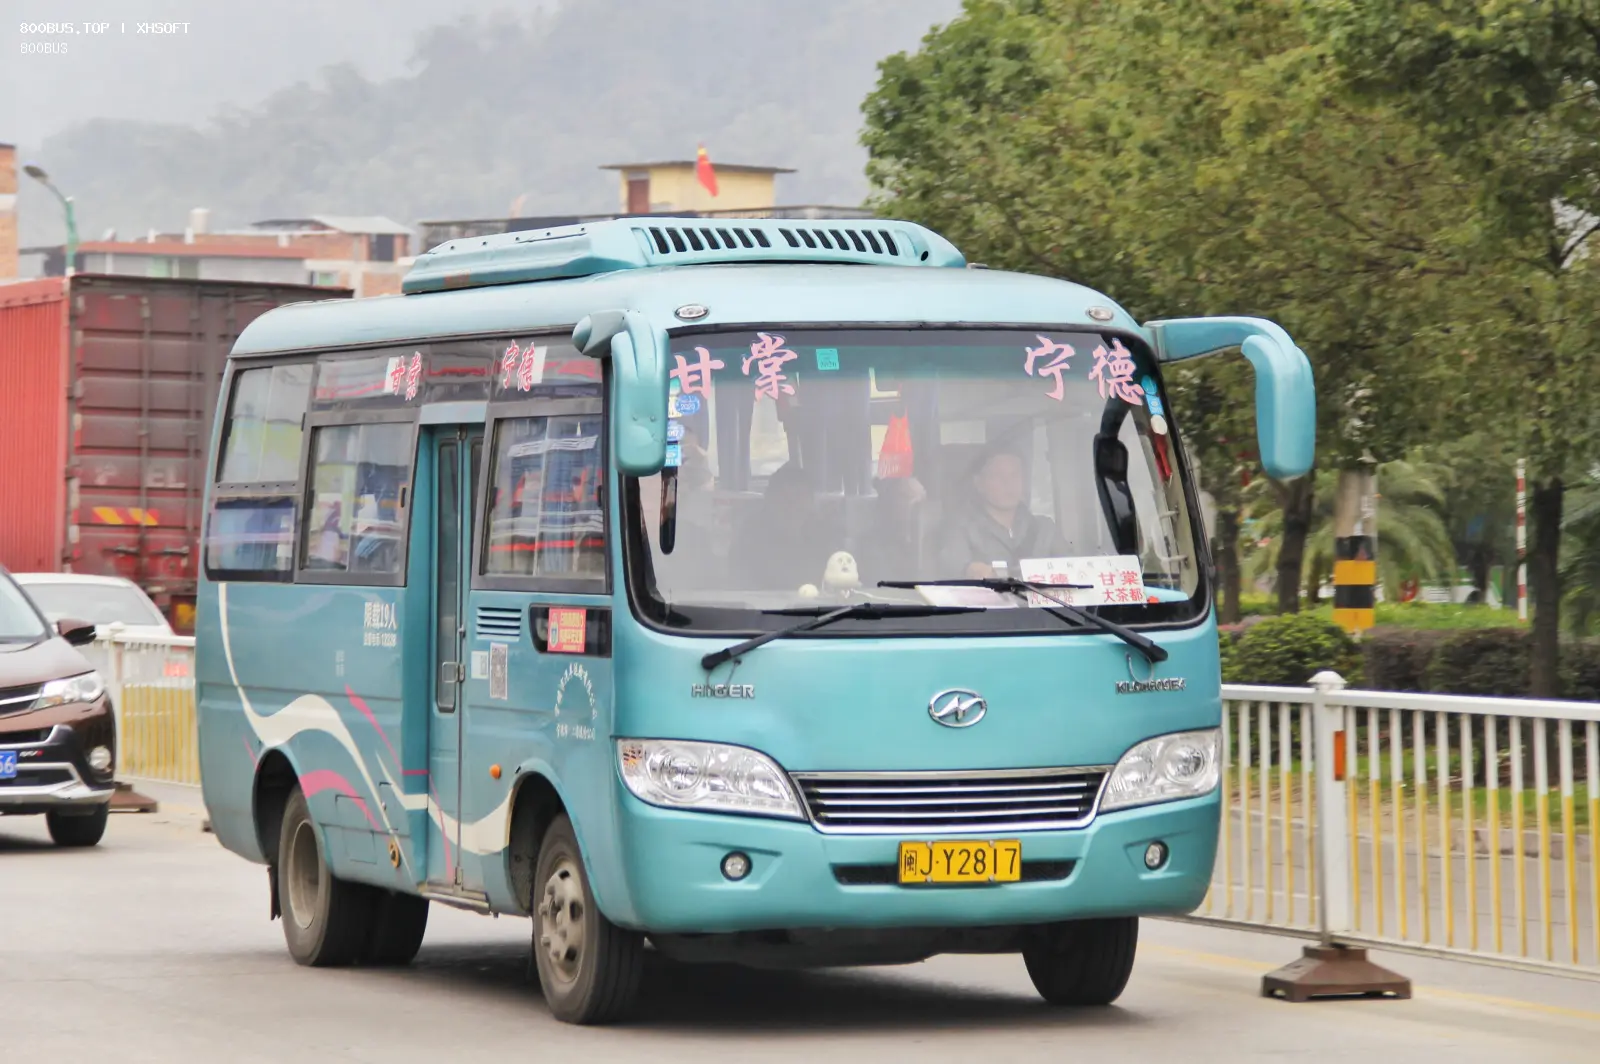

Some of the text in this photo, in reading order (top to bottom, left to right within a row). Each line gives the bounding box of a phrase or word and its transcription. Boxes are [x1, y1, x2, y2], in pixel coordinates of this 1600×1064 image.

[390, 339, 535, 401] 甘棠 宁德
[670, 332, 1145, 406] 甘棠 宁德
[1099, 571, 1138, 587] 甘棠
[1104, 588, 1143, 603] 大茶都
